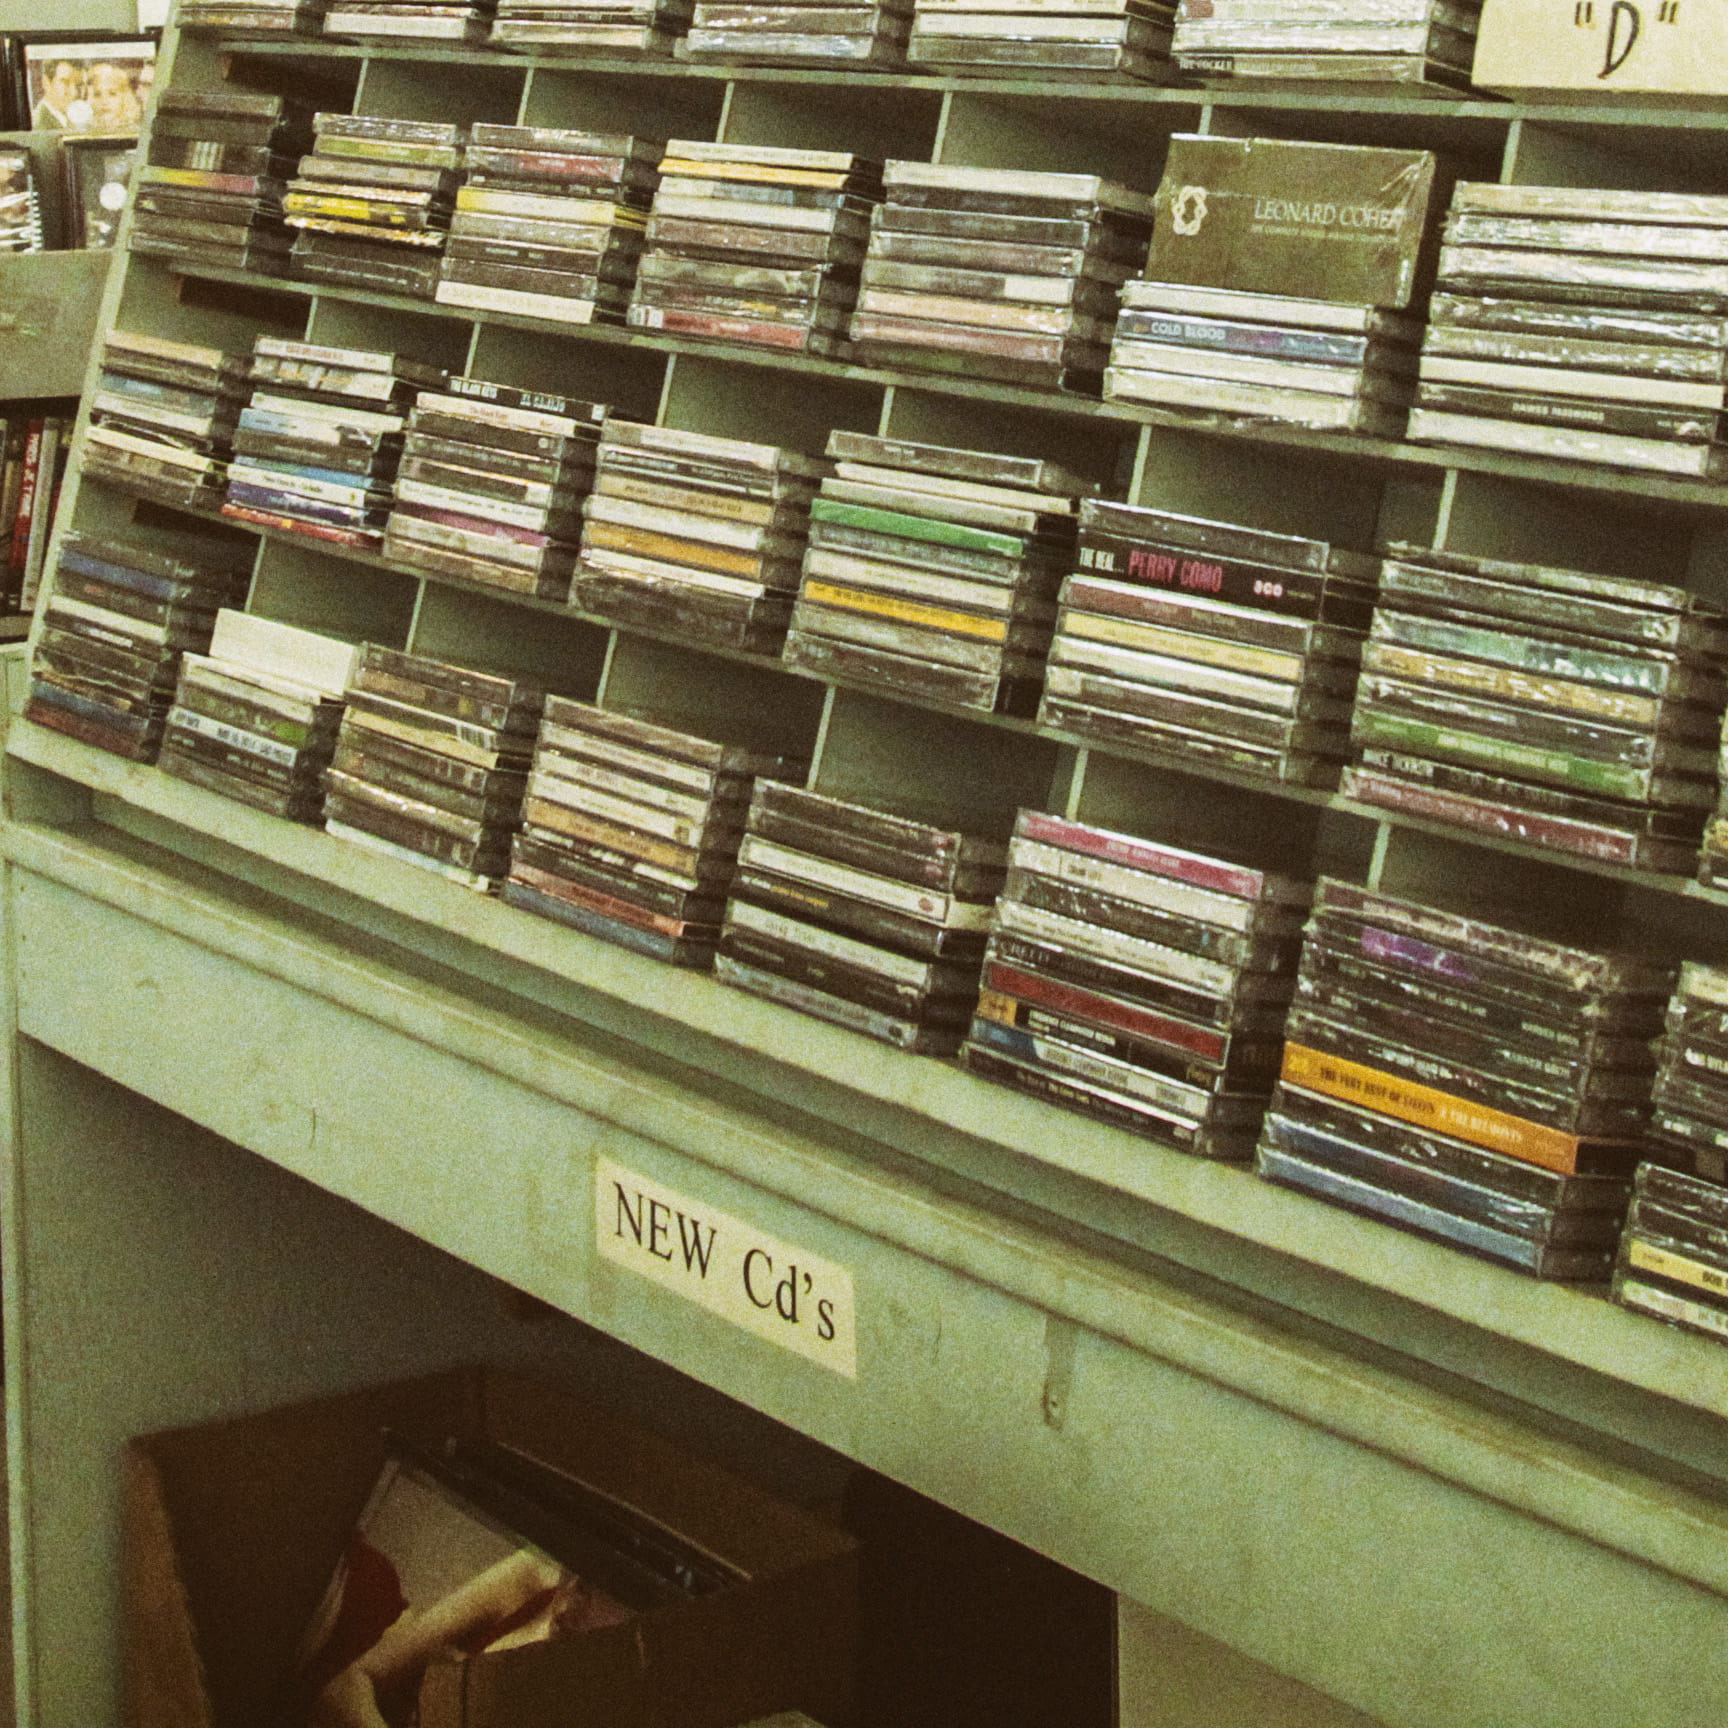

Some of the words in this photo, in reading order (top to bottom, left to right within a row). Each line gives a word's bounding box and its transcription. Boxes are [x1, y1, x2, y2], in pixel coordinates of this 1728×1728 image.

[1253, 199, 1334, 225] LEONARD
[1150, 320, 1181, 336] COLD
[1184, 324, 1227, 341] BLOOD
[1127, 551, 1177, 584] PERRY
[1179, 559, 1224, 591] COMO
[612, 1180, 718, 1280] NEW
[741, 1247, 836, 1342] Cd's
[1701, 1270, 1718, 1288] BOB
